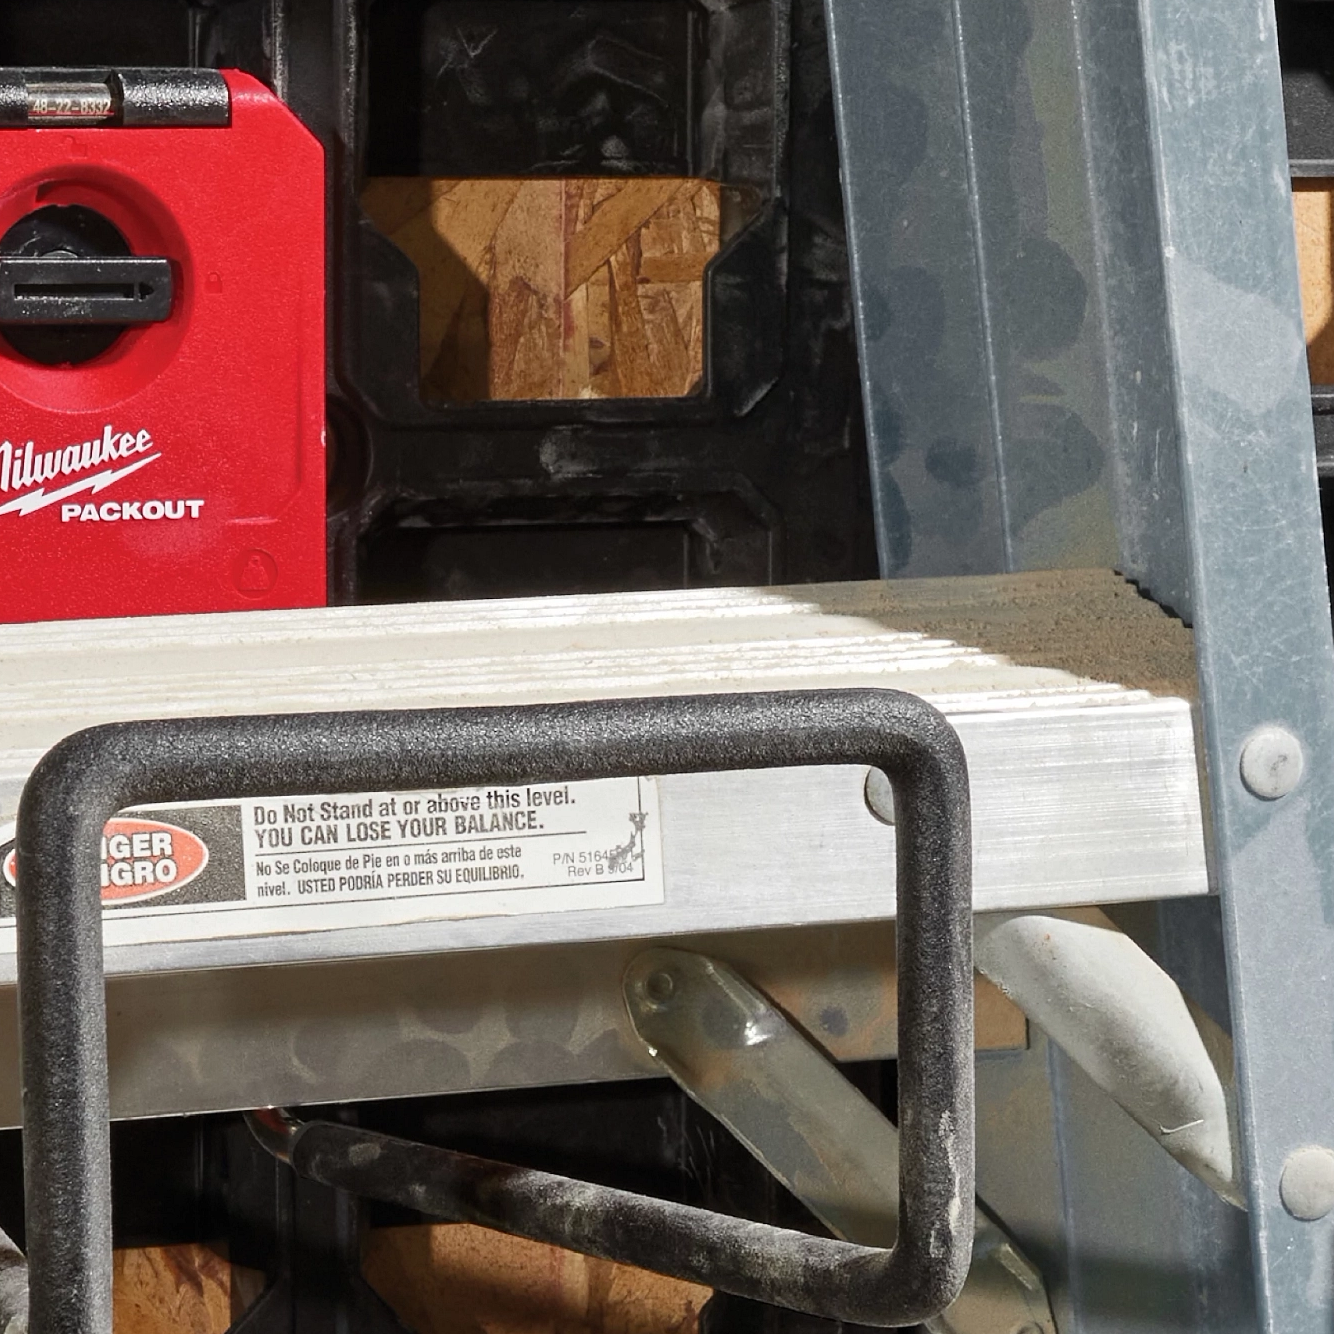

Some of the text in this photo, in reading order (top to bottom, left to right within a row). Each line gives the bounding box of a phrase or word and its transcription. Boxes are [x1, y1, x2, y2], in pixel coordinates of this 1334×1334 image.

[33, 96, 113, 117] 48-22-8332
[61, 499, 205, 523] PACKOUT
[254, 786, 575, 825] Do Not Stand at or above this level.
[255, 810, 544, 848] YOU CAN LOSE YOUR BALANCE.
[101, 831, 173, 860] GER
[553, 853, 575, 865] P/N
[101, 860, 179, 887] IGRO
[256, 844, 521, 876] No Se Coloque de Pie en o más arriba de este
[568, 866, 592, 877] Rev
[596, 864, 604, 875] B
[257, 864, 524, 897] nivel. USTED PODRÍA PERDER SU EQUILIBRIO.
